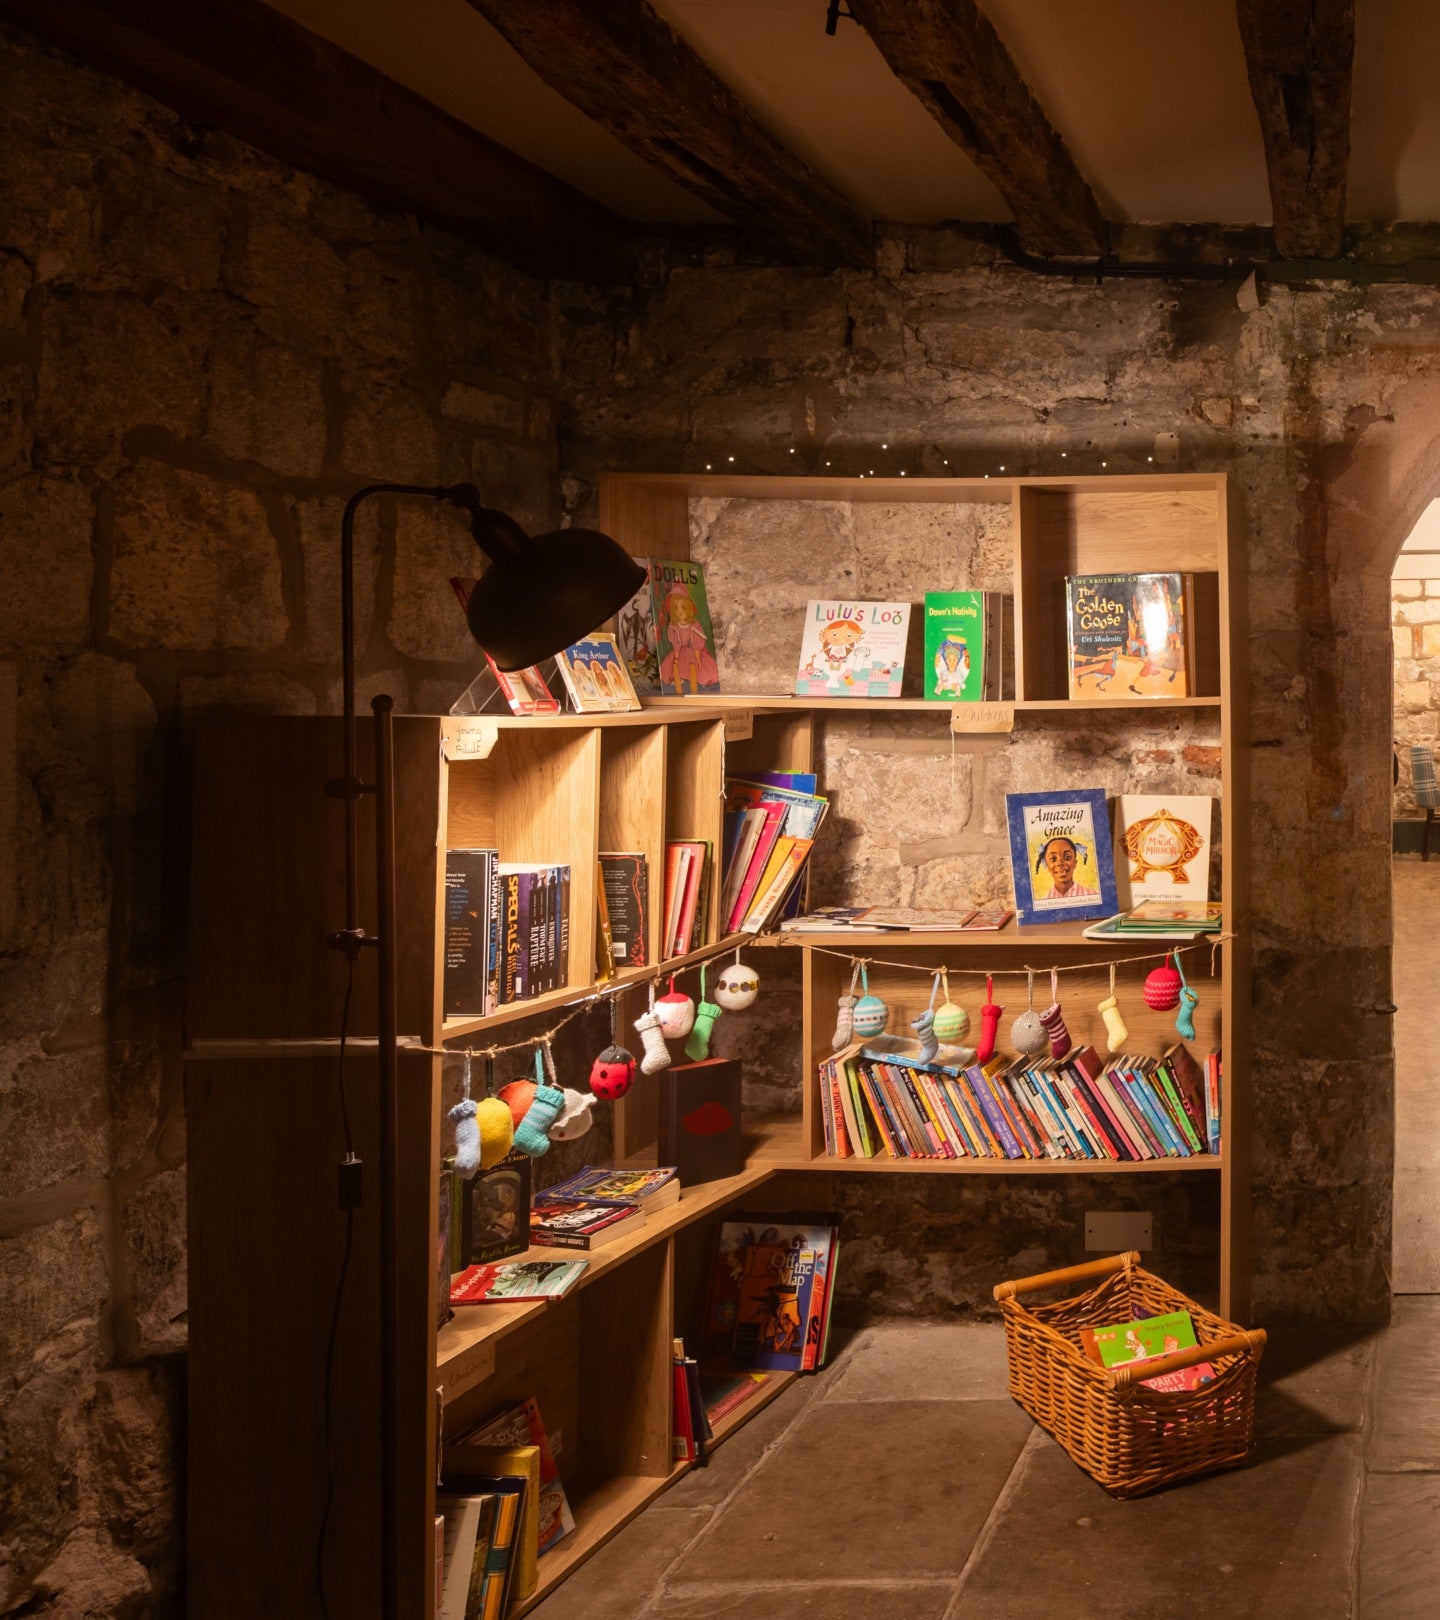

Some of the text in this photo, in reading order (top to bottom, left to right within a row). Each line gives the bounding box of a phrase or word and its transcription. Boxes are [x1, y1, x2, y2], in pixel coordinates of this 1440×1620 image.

[654, 565, 698, 585] DOLLS
[1078, 586, 1096, 598] The
[928, 607, 977, 618] Dawn's Nativity
[1075, 596, 1124, 615] Golden
[1080, 613, 1121, 630] Goose
[1093, 635, 1122, 643] Shulevitz
[572, 649, 609, 661] King Arthur
[455, 724, 482, 742] Young
[455, 742, 481, 754] Adult
[1031, 807, 1084, 825] Amazing
[1044, 822, 1076, 838] Grace
[1146, 846, 1178, 856] MIRROR
[490, 857, 499, 920] JIM CHAPMAN
[506, 875, 519, 954] SPECIALS
[538, 924, 546, 964] TORMENT
[560, 919, 569, 952] FALLEN
[530, 926, 539, 967] RAPTURE
[833, 1092, 844, 1130] FUNNY GIRL
[772, 1251, 798, 1269] Off
[794, 1262, 812, 1275] the
[777, 1269, 805, 1290] Map
[1148, 1370, 1186, 1389] PARTY
